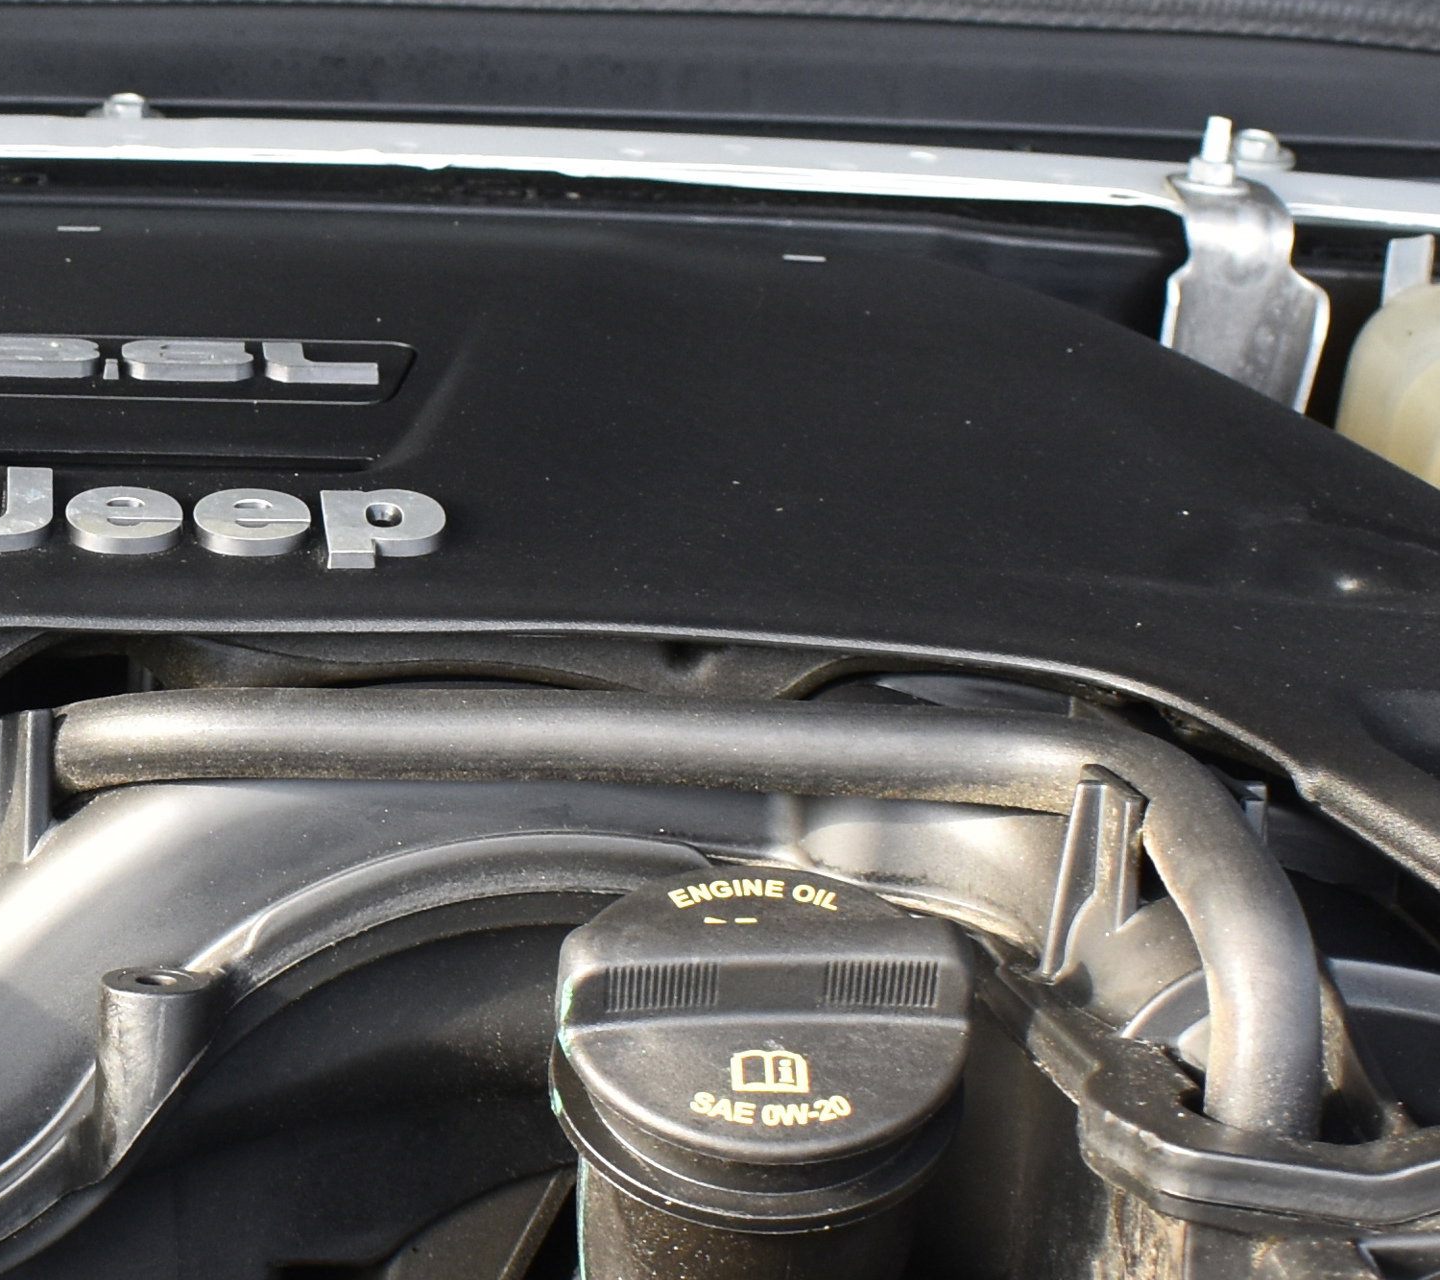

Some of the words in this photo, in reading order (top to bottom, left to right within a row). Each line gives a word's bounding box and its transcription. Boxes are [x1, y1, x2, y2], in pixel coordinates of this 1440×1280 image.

[667, 878, 785, 909] ENGINE
[791, 884, 839, 912] OIL
[690, 1091, 756, 1125] SAE
[761, 1094, 852, 1127] 0W-20
